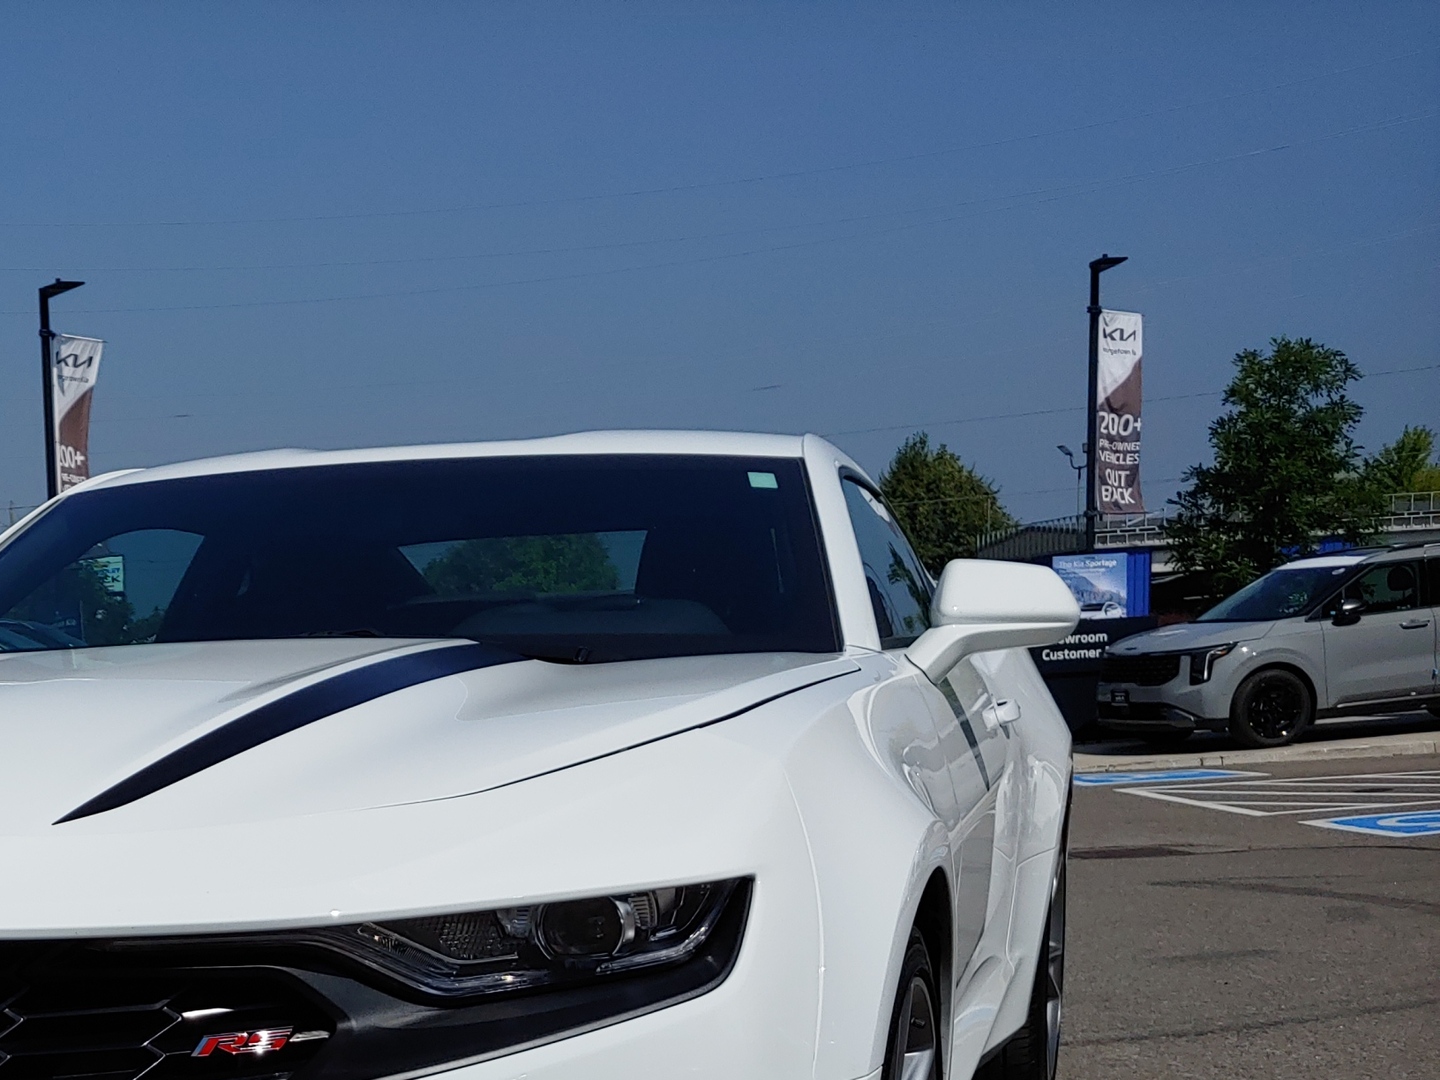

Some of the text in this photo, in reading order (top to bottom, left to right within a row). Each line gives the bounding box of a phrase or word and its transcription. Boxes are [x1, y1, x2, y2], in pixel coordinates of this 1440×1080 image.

[1103, 327, 1137, 342] KIA
[55, 351, 93, 369] KIA
[1099, 412, 1142, 436] 200+
[60, 445, 86, 469] 00+
[1099, 450, 1140, 465] VEHICLES
[1105, 470, 1131, 487] OUT
[1101, 485, 1136, 504] BACK
[1085, 559, 1117, 568] Sportage
[1042, 649, 1102, 661] Customer
[191, 1026, 294, 1057] RS
